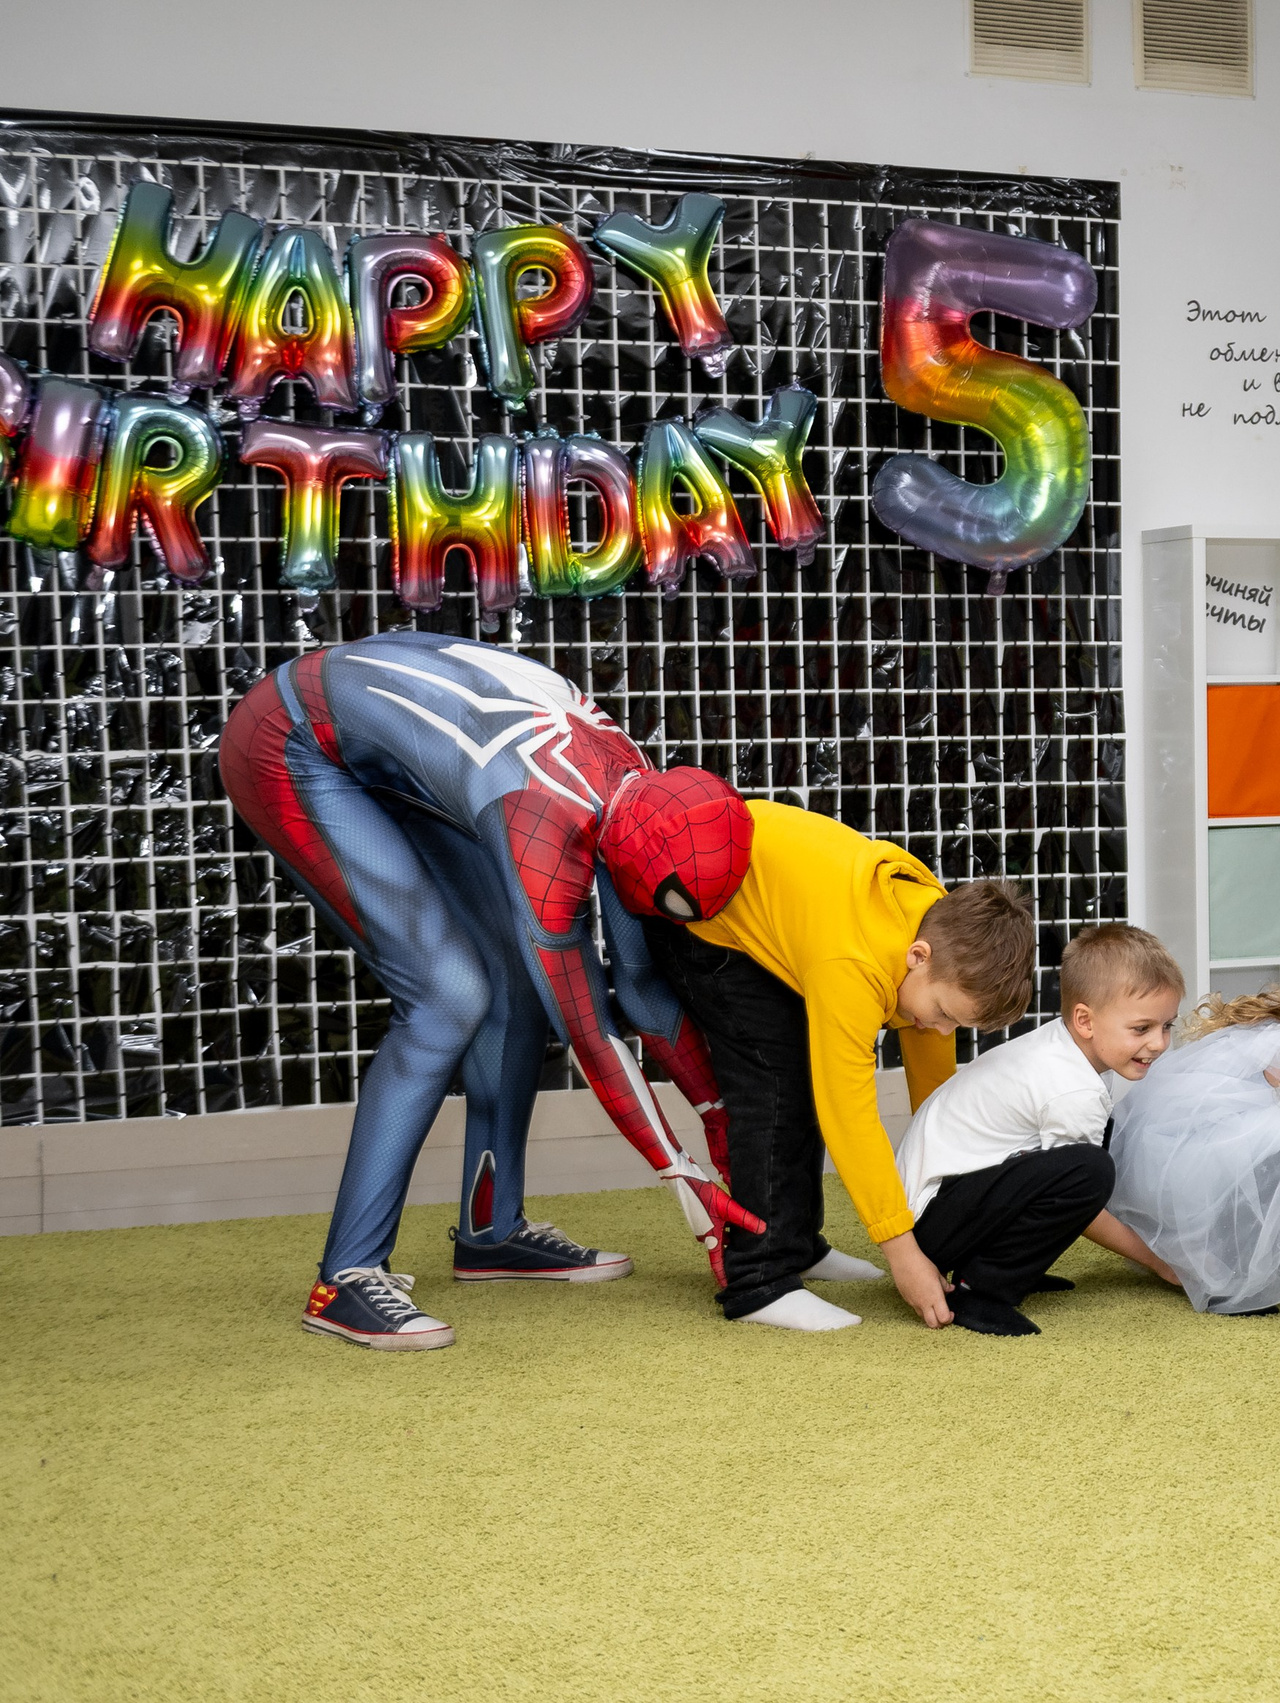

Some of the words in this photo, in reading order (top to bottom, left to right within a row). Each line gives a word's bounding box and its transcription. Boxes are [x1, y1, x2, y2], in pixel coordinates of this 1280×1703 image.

[88, 181, 733, 412] HAPPY
[1186, 299, 1268, 324] Этот
[872, 217, 1098, 572] 5
[1242, 378, 1262, 392] и
[1181, 401, 1212, 418] не
